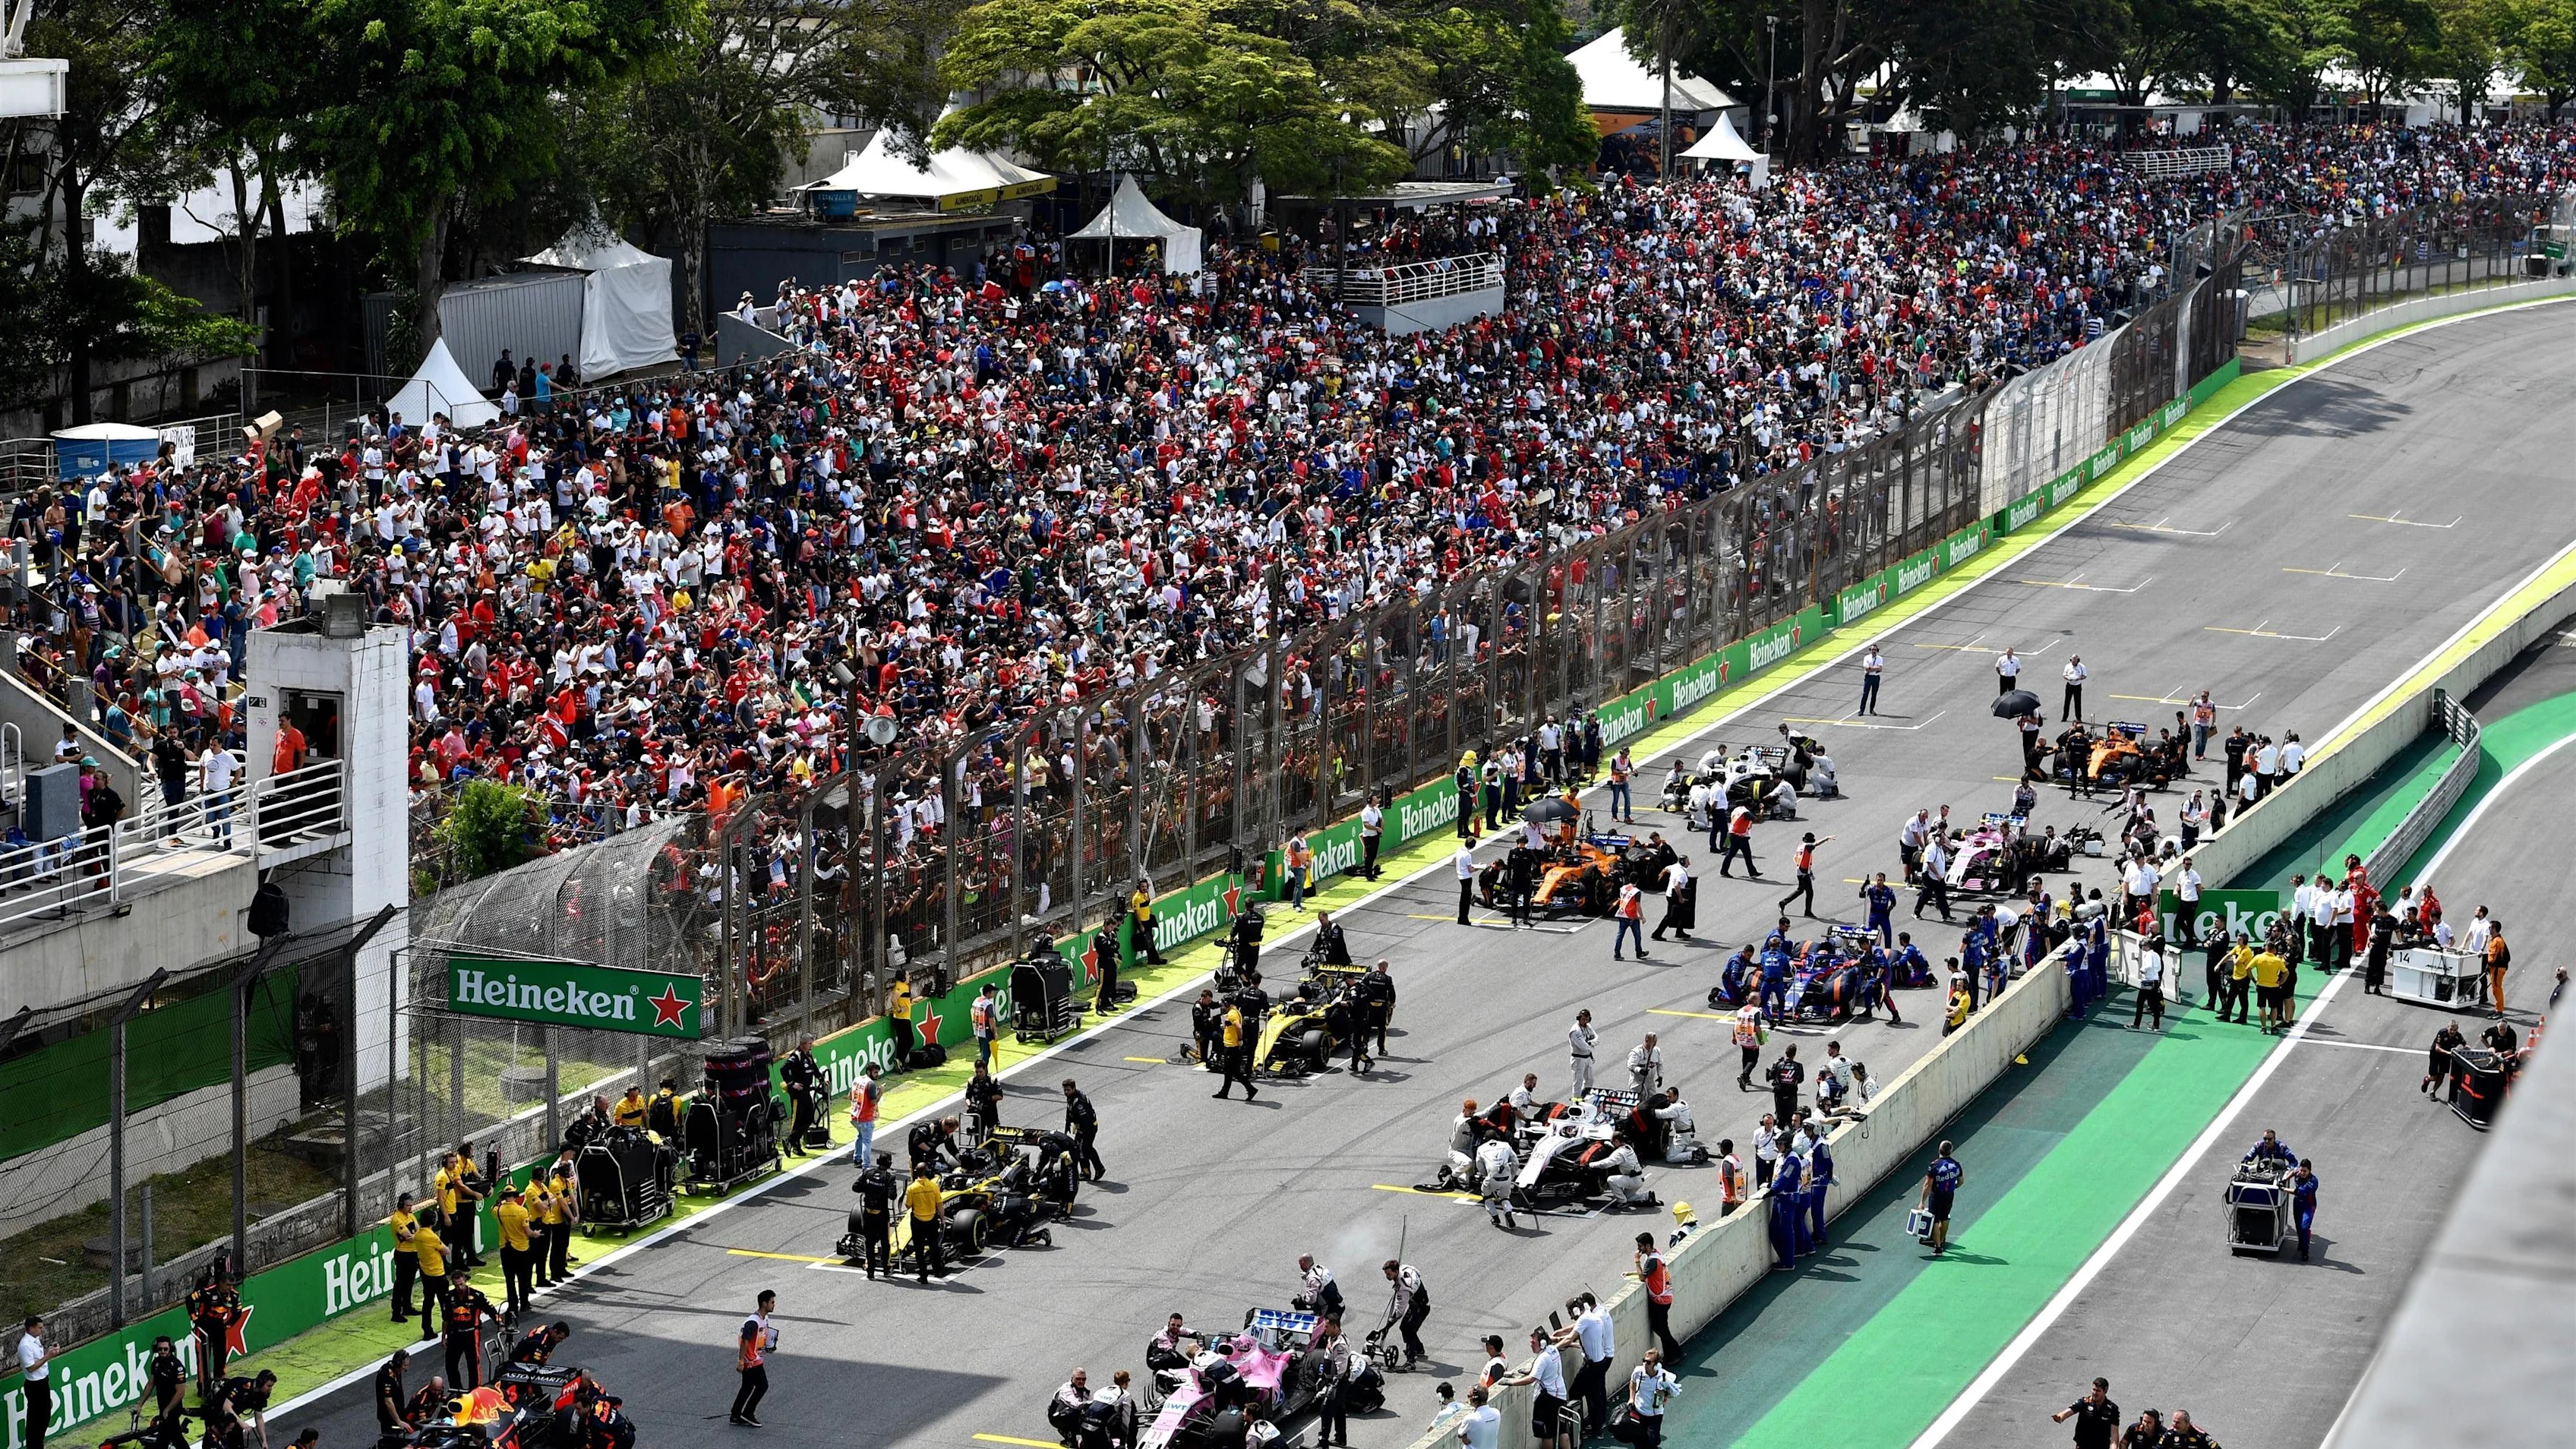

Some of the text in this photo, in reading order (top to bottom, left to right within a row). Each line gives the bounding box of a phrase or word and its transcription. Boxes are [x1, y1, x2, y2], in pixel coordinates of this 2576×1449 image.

[955, 193, 983, 206] ALIMENTAÇÃO
[2165, 400, 2186, 428] Heineken
[2130, 424, 2152, 453] Heineken
[2093, 448, 2117, 479] Heineken
[2052, 475, 2078, 507] Heineken
[2009, 497, 2037, 531] Heineken
[1949, 533, 1978, 567] Heineken
[1899, 557, 1930, 594] Heineken
[1842, 588, 1877, 623] Heineken
[1750, 627, 1790, 671] Heineken
[1672, 670, 1717, 712] Heineken
[1136, 898, 1219, 959] eineken
[2399, 952, 2410, 964] 14
[456, 969, 636, 1021] Heineken
[1589, 1089, 1638, 1100] MARTINI
[4, 1334, 198, 1448] Heinekn
[503, 1372, 570, 1384] ASTON MARTIN
[1163, 1401, 1188, 1411] BWT
